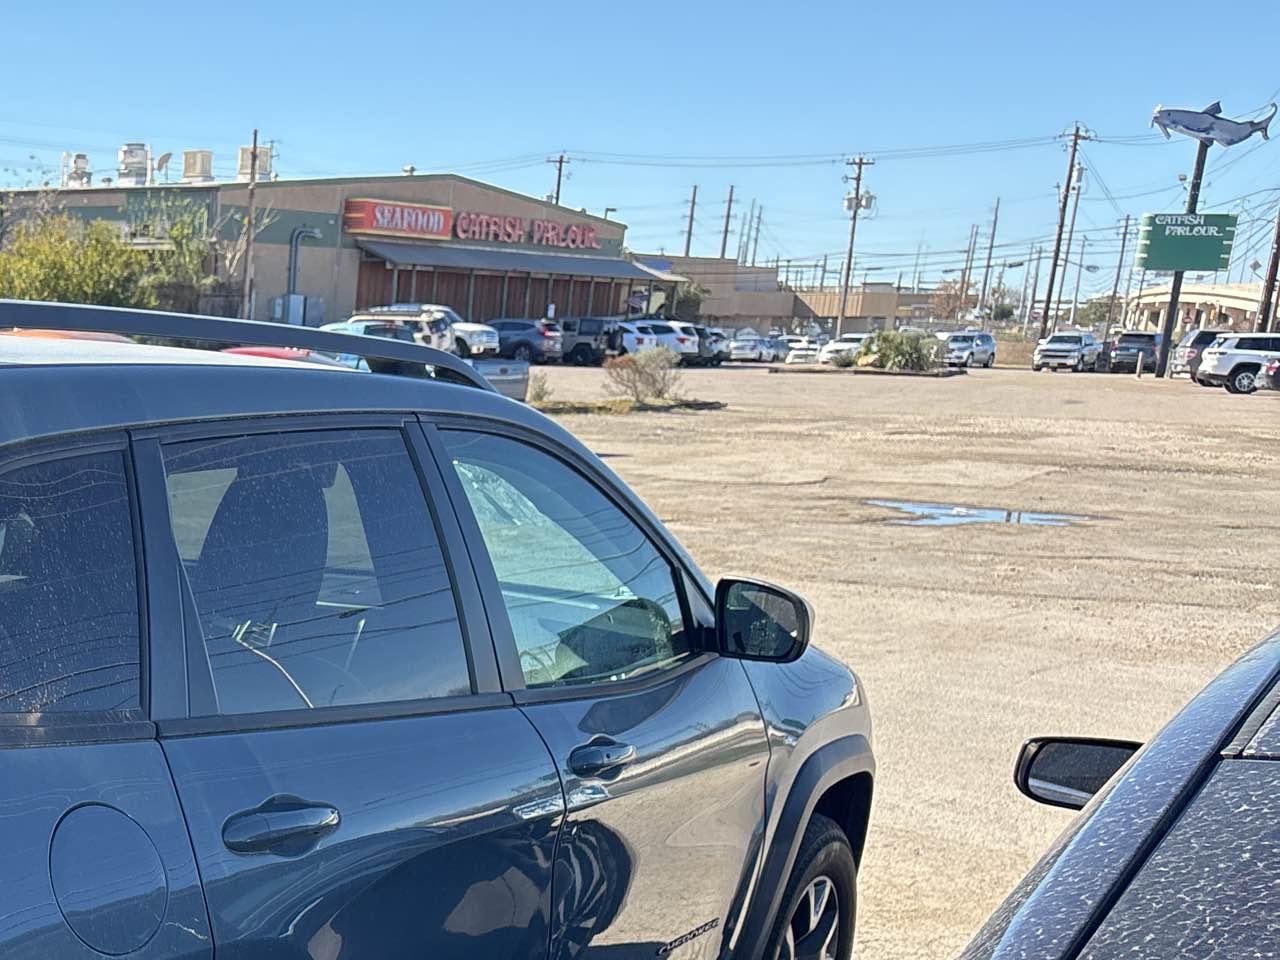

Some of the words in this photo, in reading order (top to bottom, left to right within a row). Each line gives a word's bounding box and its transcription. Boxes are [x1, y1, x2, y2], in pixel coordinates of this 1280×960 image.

[374, 205, 445, 233] SEAFOOD
[1155, 215, 1205, 225] CATFISH
[456, 212, 526, 243] CATFISH
[532, 221, 602, 250] PARLOUR
[1165, 226, 1224, 236] PARLOUR
